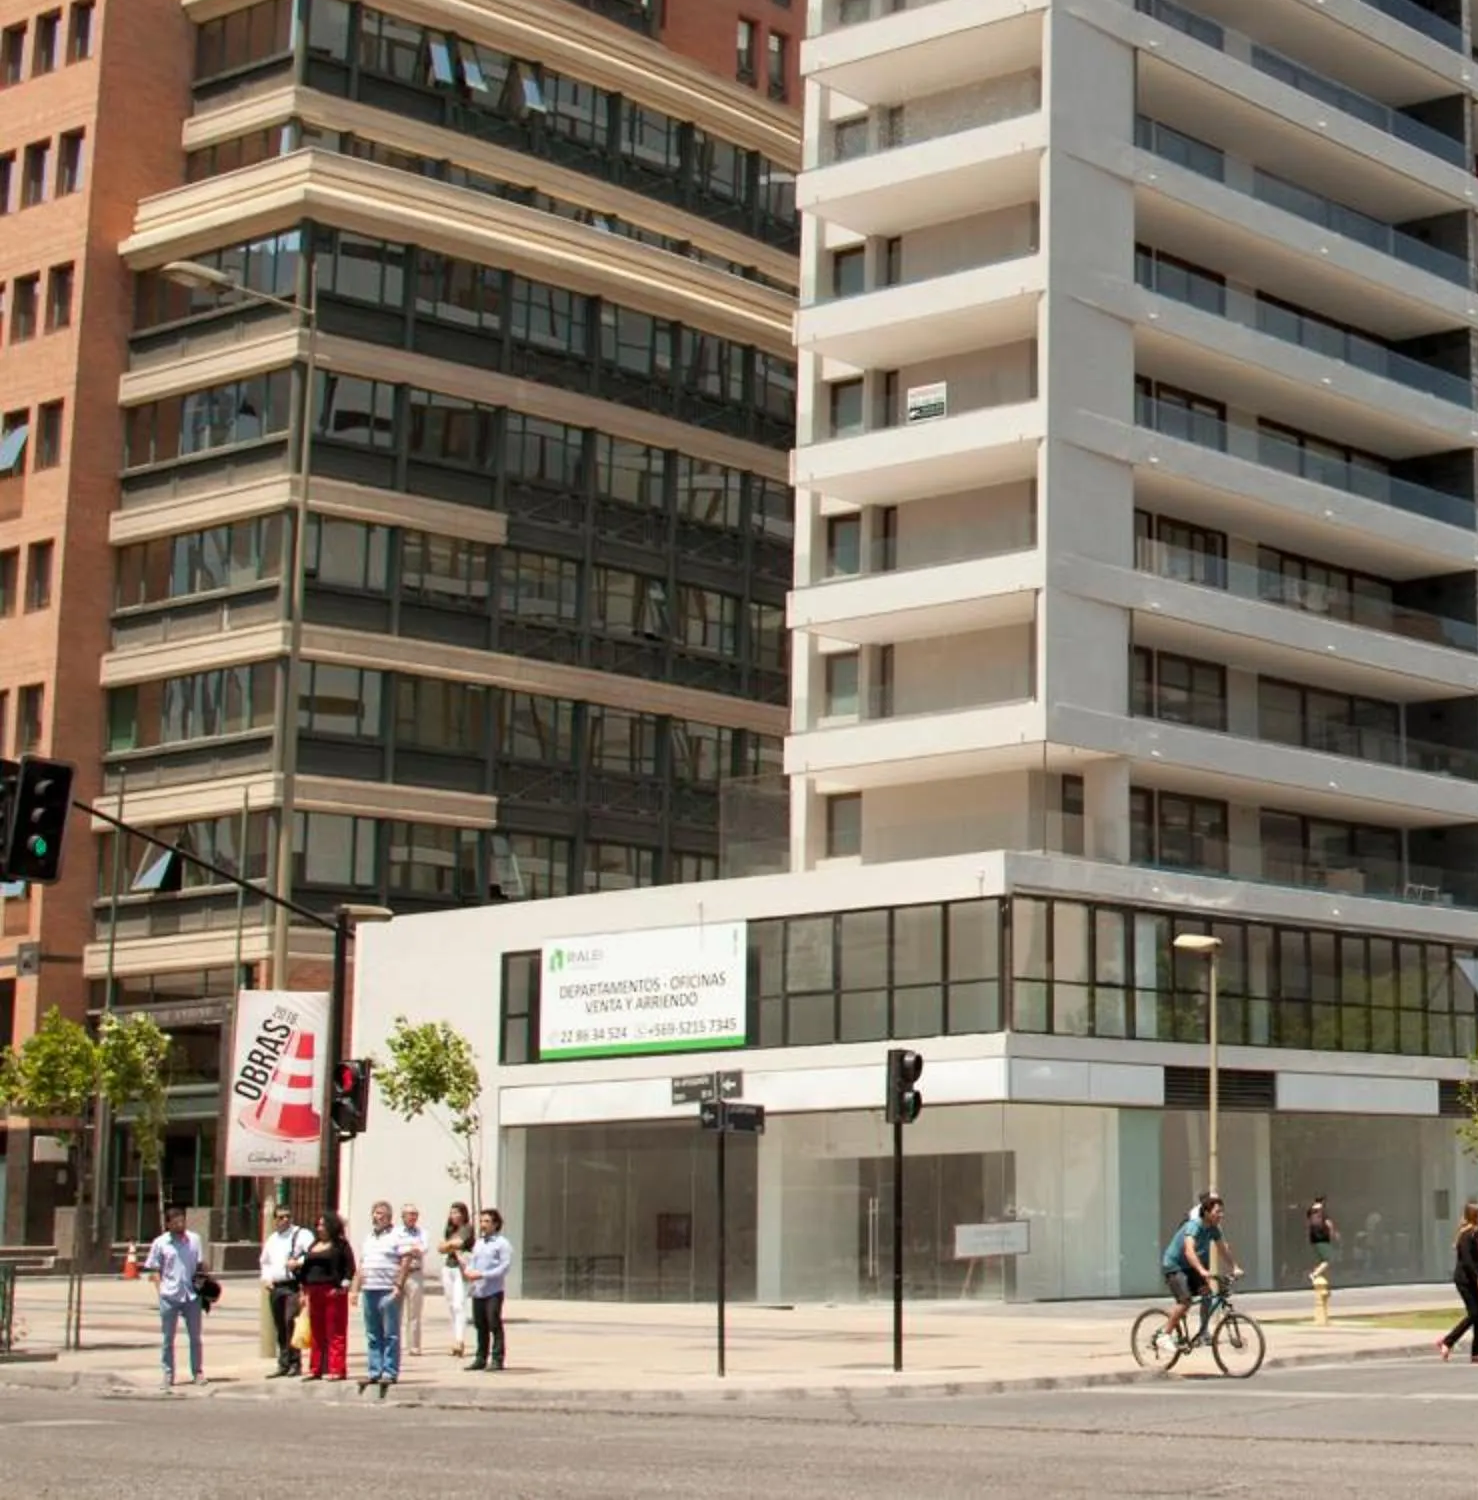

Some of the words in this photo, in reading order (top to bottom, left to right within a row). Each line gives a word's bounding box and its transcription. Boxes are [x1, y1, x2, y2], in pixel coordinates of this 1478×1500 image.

[559, 976, 661, 1000] DEPARTAMENTOS
[670, 971, 726, 990] OFICINAS
[585, 998, 622, 1013] VENTA
[625, 998, 633, 1010] Y
[635, 991, 698, 1011] ARRIENDO
[234, 1018, 291, 1101] OBRAS
